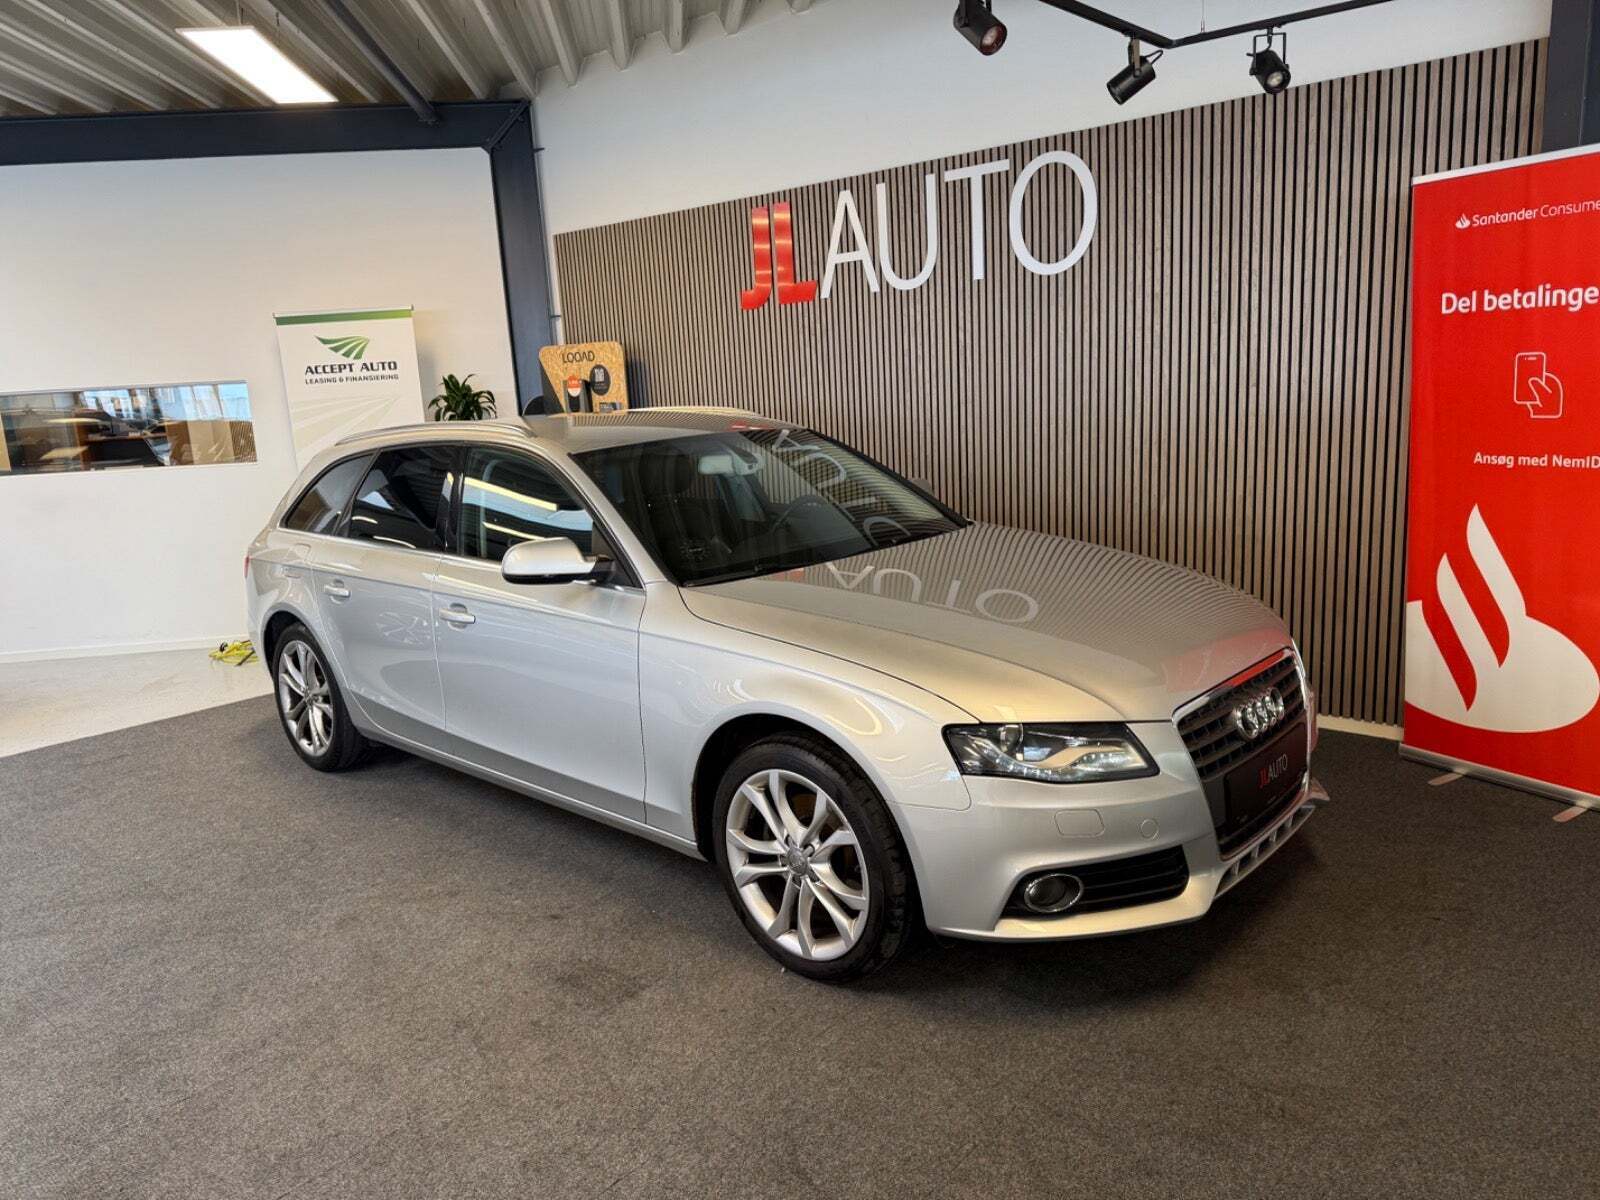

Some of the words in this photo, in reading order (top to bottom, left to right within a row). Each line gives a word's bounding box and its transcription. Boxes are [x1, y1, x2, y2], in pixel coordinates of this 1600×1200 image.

[1472, 208, 1538, 227] Santander
[1441, 290, 1477, 314] Del
[1483, 283, 1600, 312] betalinge
[304, 363, 354, 375] ACCEPT
[360, 361, 397, 372] AUTO
[305, 377, 337, 385] LEASING
[345, 374, 399, 383] FINANSIERING
[1474, 452, 1514, 468] Ansøg
[1518, 454, 1548, 466] med
[1552, 454, 1600, 469] NemID
